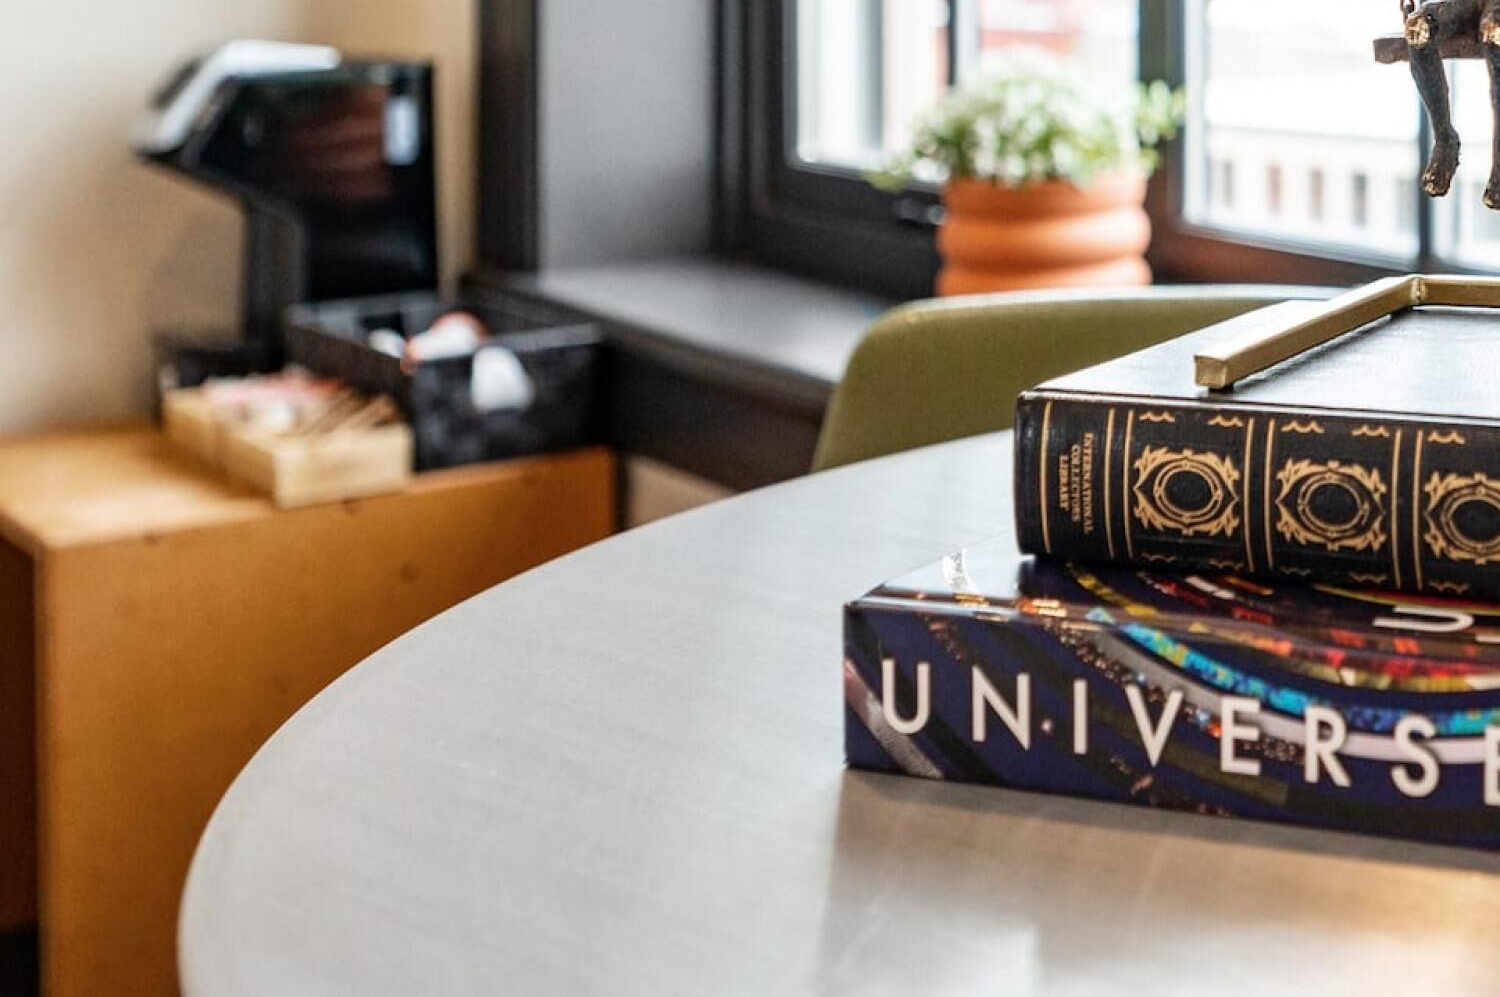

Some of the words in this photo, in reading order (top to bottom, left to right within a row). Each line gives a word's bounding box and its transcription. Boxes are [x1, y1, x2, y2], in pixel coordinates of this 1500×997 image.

[1059, 454, 1069, 511] LIBRARY
[1071, 443, 1081, 522] COLLECTORS
[1082, 432, 1094, 534] INTERNATIONAL
